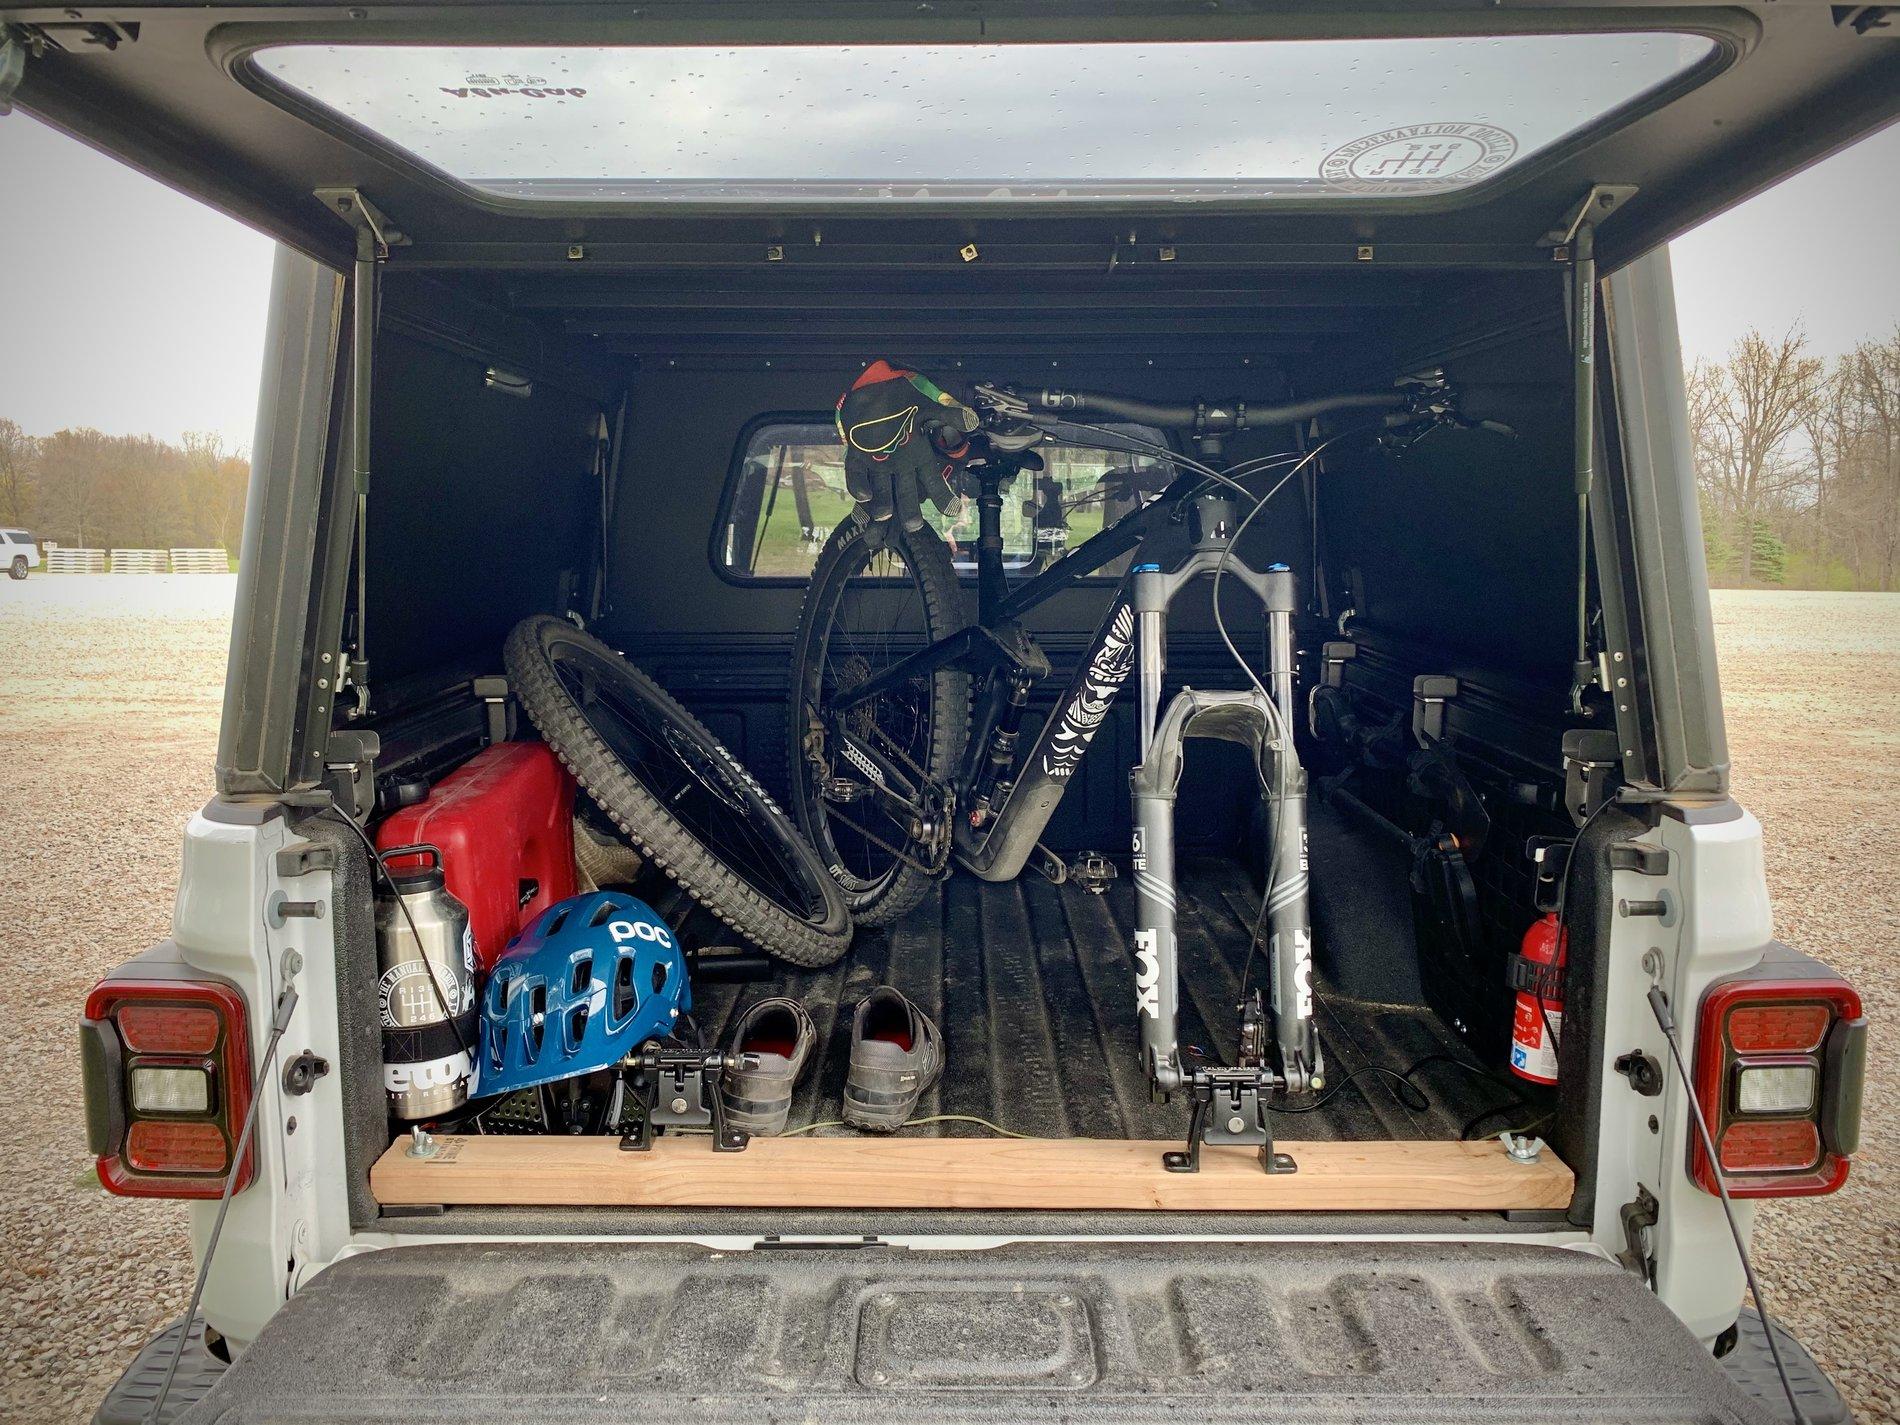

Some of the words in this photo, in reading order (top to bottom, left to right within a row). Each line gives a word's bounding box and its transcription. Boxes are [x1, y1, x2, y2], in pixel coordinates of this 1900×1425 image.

[837, 524, 866, 550] MAXX
[379, 980, 392, 997] THE
[386, 962, 424, 984] MANUAL
[1134, 928, 1160, 1019] FOX
[410, 1015, 418, 1023] 2
[419, 1014, 427, 1022] 4
